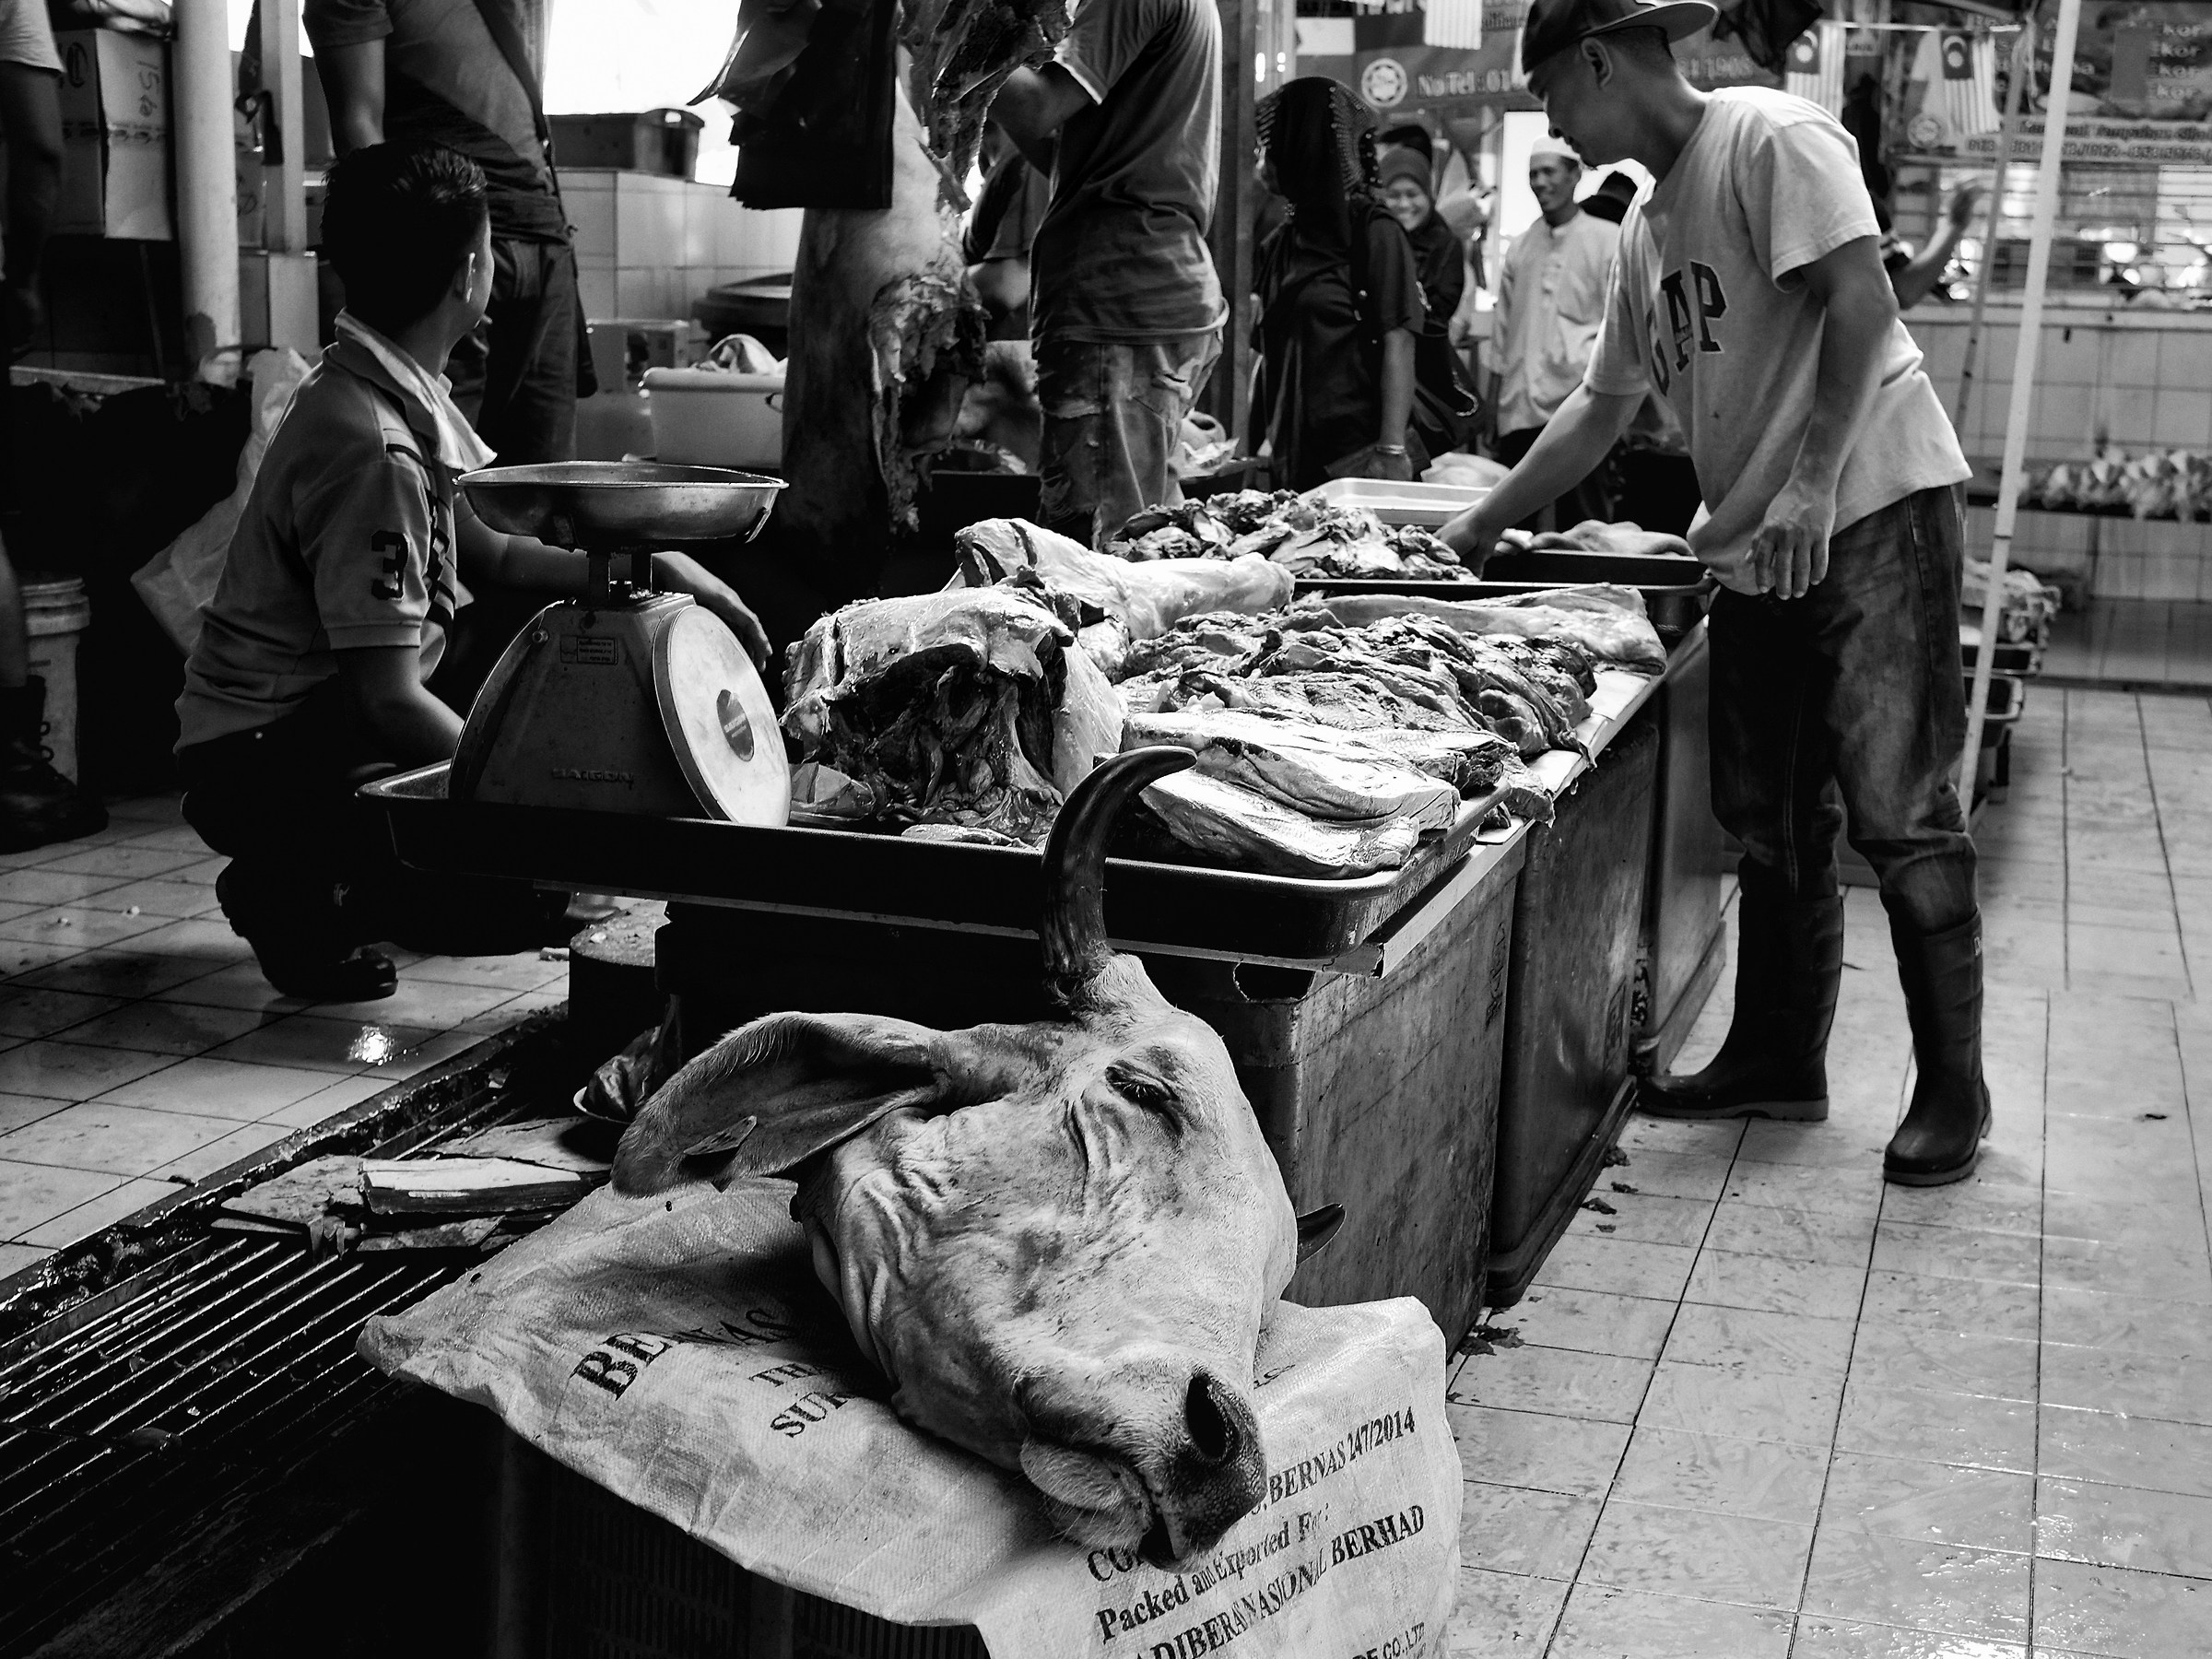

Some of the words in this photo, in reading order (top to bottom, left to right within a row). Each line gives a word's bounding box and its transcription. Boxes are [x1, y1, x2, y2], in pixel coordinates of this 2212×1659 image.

[1646, 259, 1729, 397] GAP
[371, 530, 409, 600] 3
[569, 1308, 800, 1402] BEAS
[1269, 1441, 1347, 1505] BERNAS
[1347, 1406, 1416, 1462] 247/2014
[1095, 1574, 1191, 1645] Packed
[1213, 1521, 1291, 1581] Exported
[1331, 1504, 1425, 1568] BERHAD
